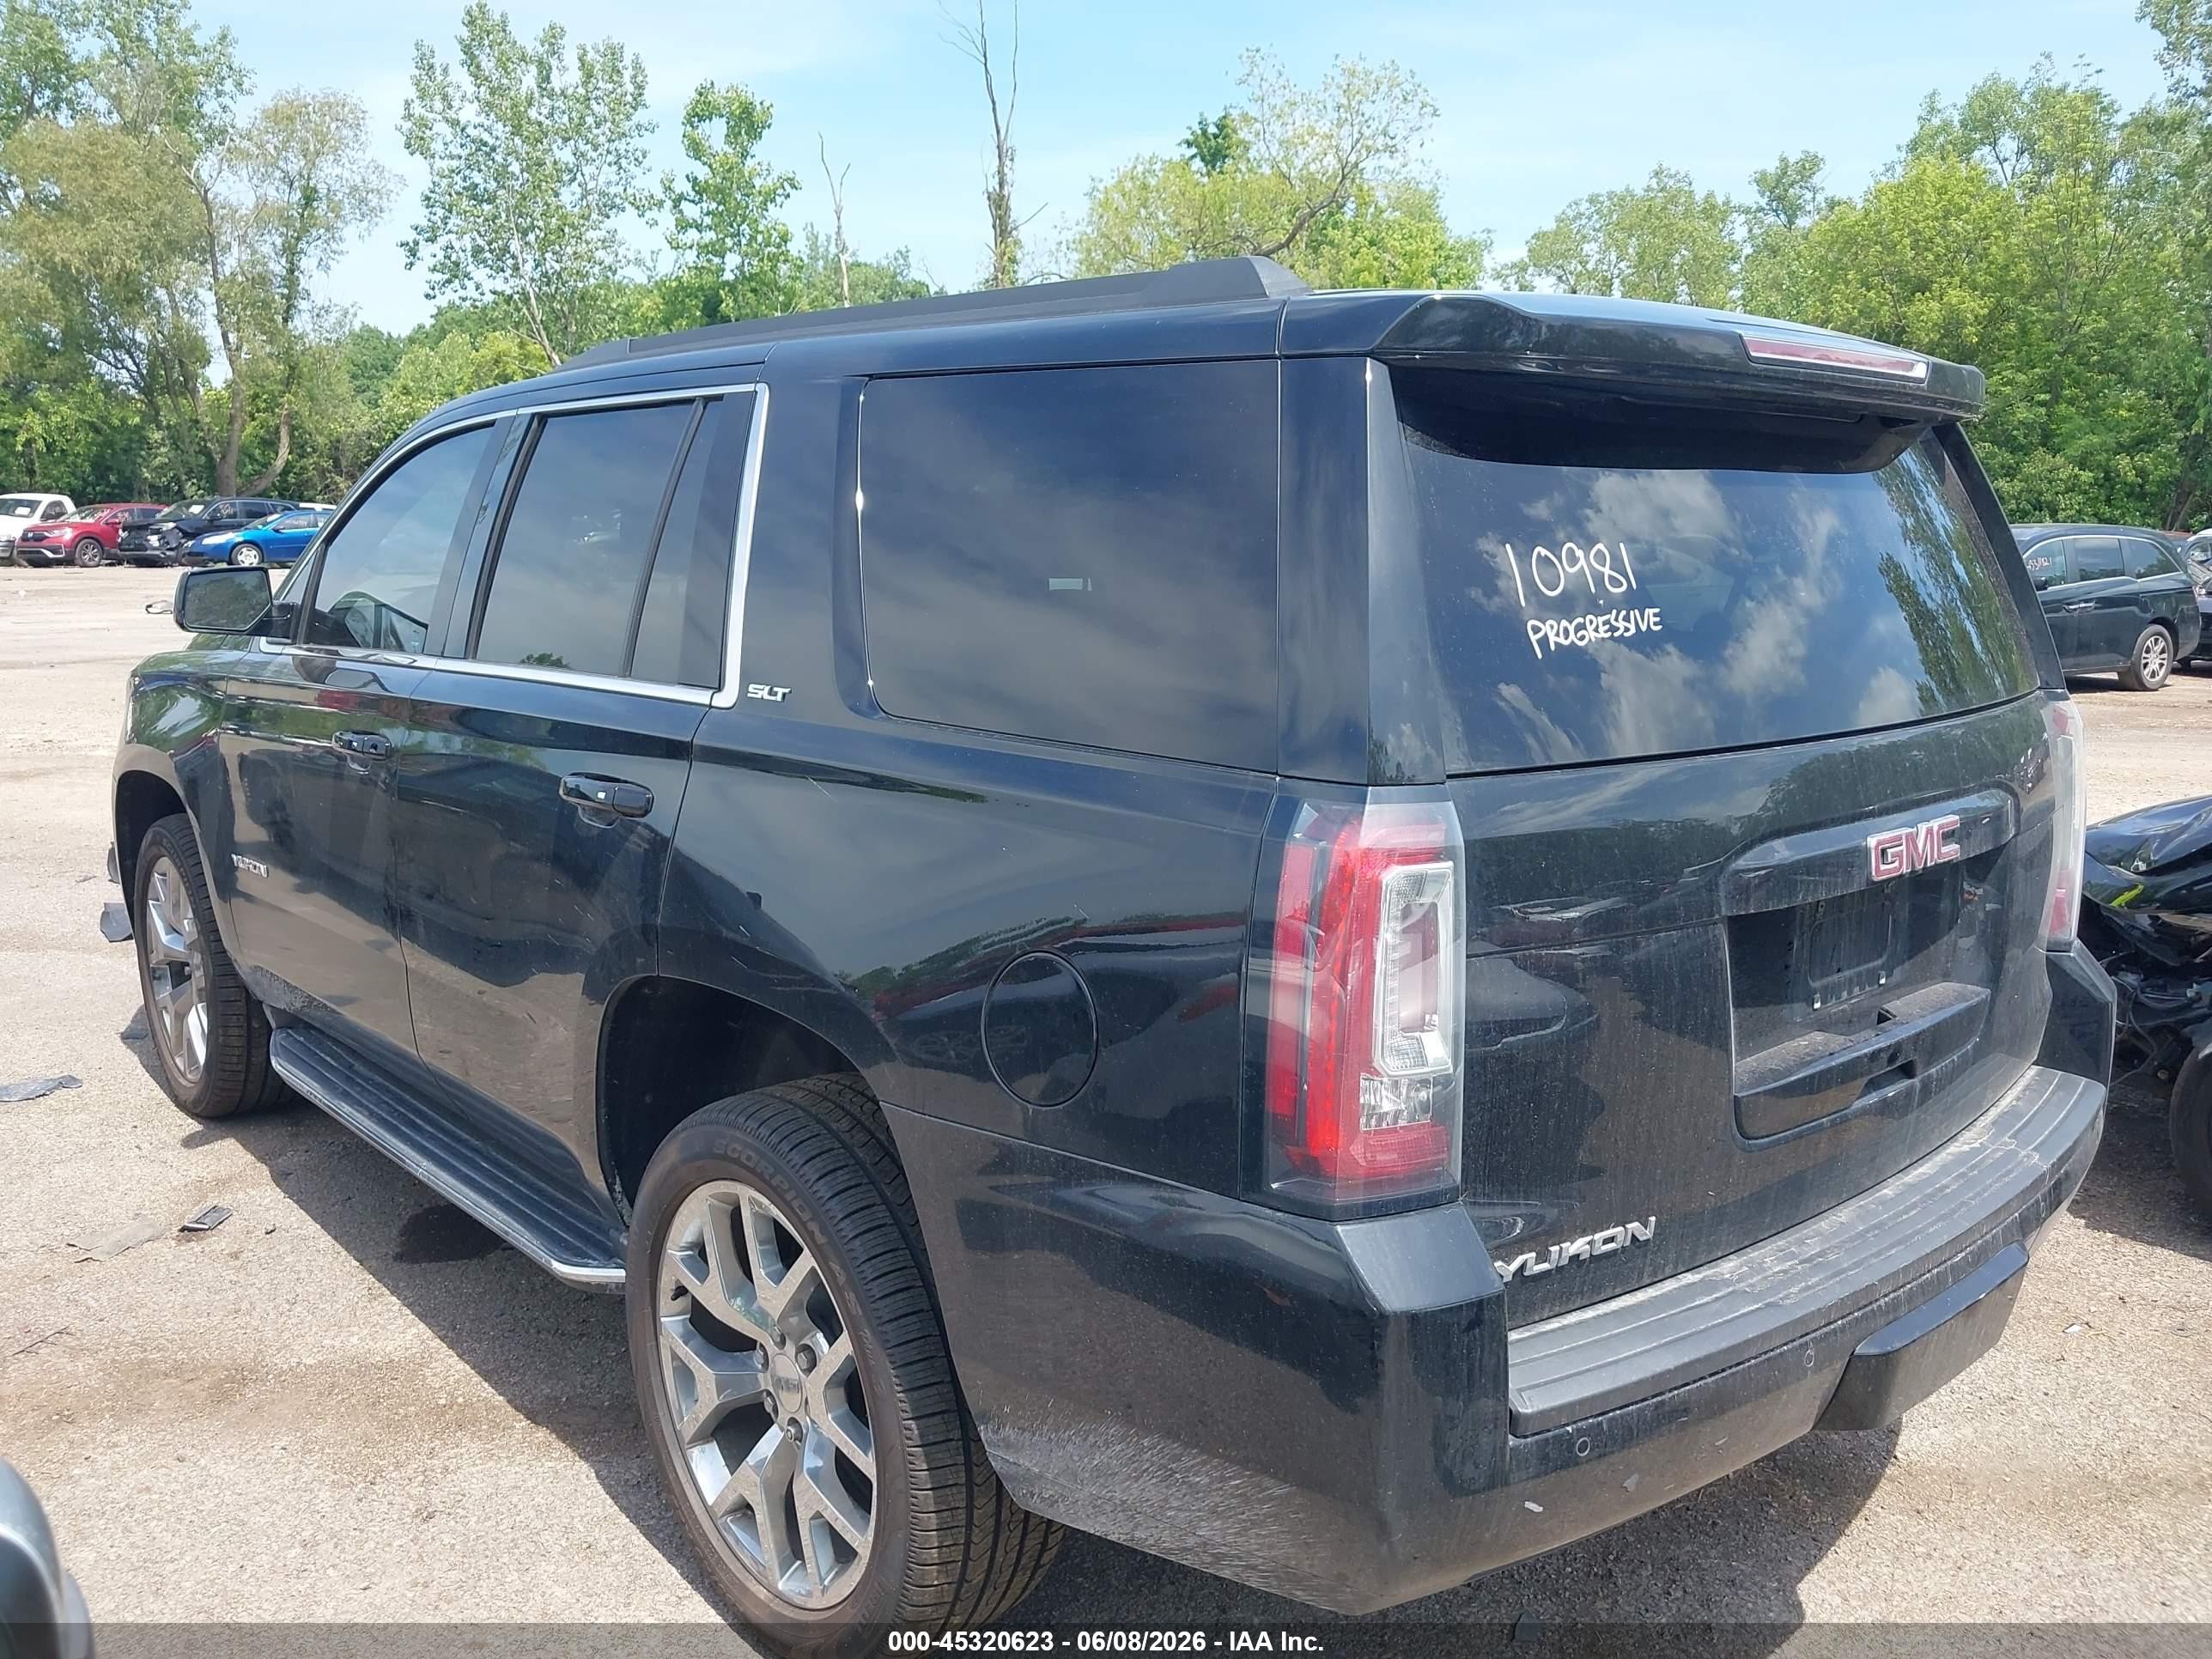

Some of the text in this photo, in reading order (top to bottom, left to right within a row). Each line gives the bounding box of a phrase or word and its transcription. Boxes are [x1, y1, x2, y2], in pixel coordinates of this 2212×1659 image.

[1504, 542, 1637, 608] 10981
[1526, 607, 1662, 659] PROGRESSIVE
[747, 683, 792, 702] SLT
[1867, 814, 1960, 881] GMC
[714, 1138, 829, 1245] SCORPION
[1493, 1215, 1656, 1283] YUKON
